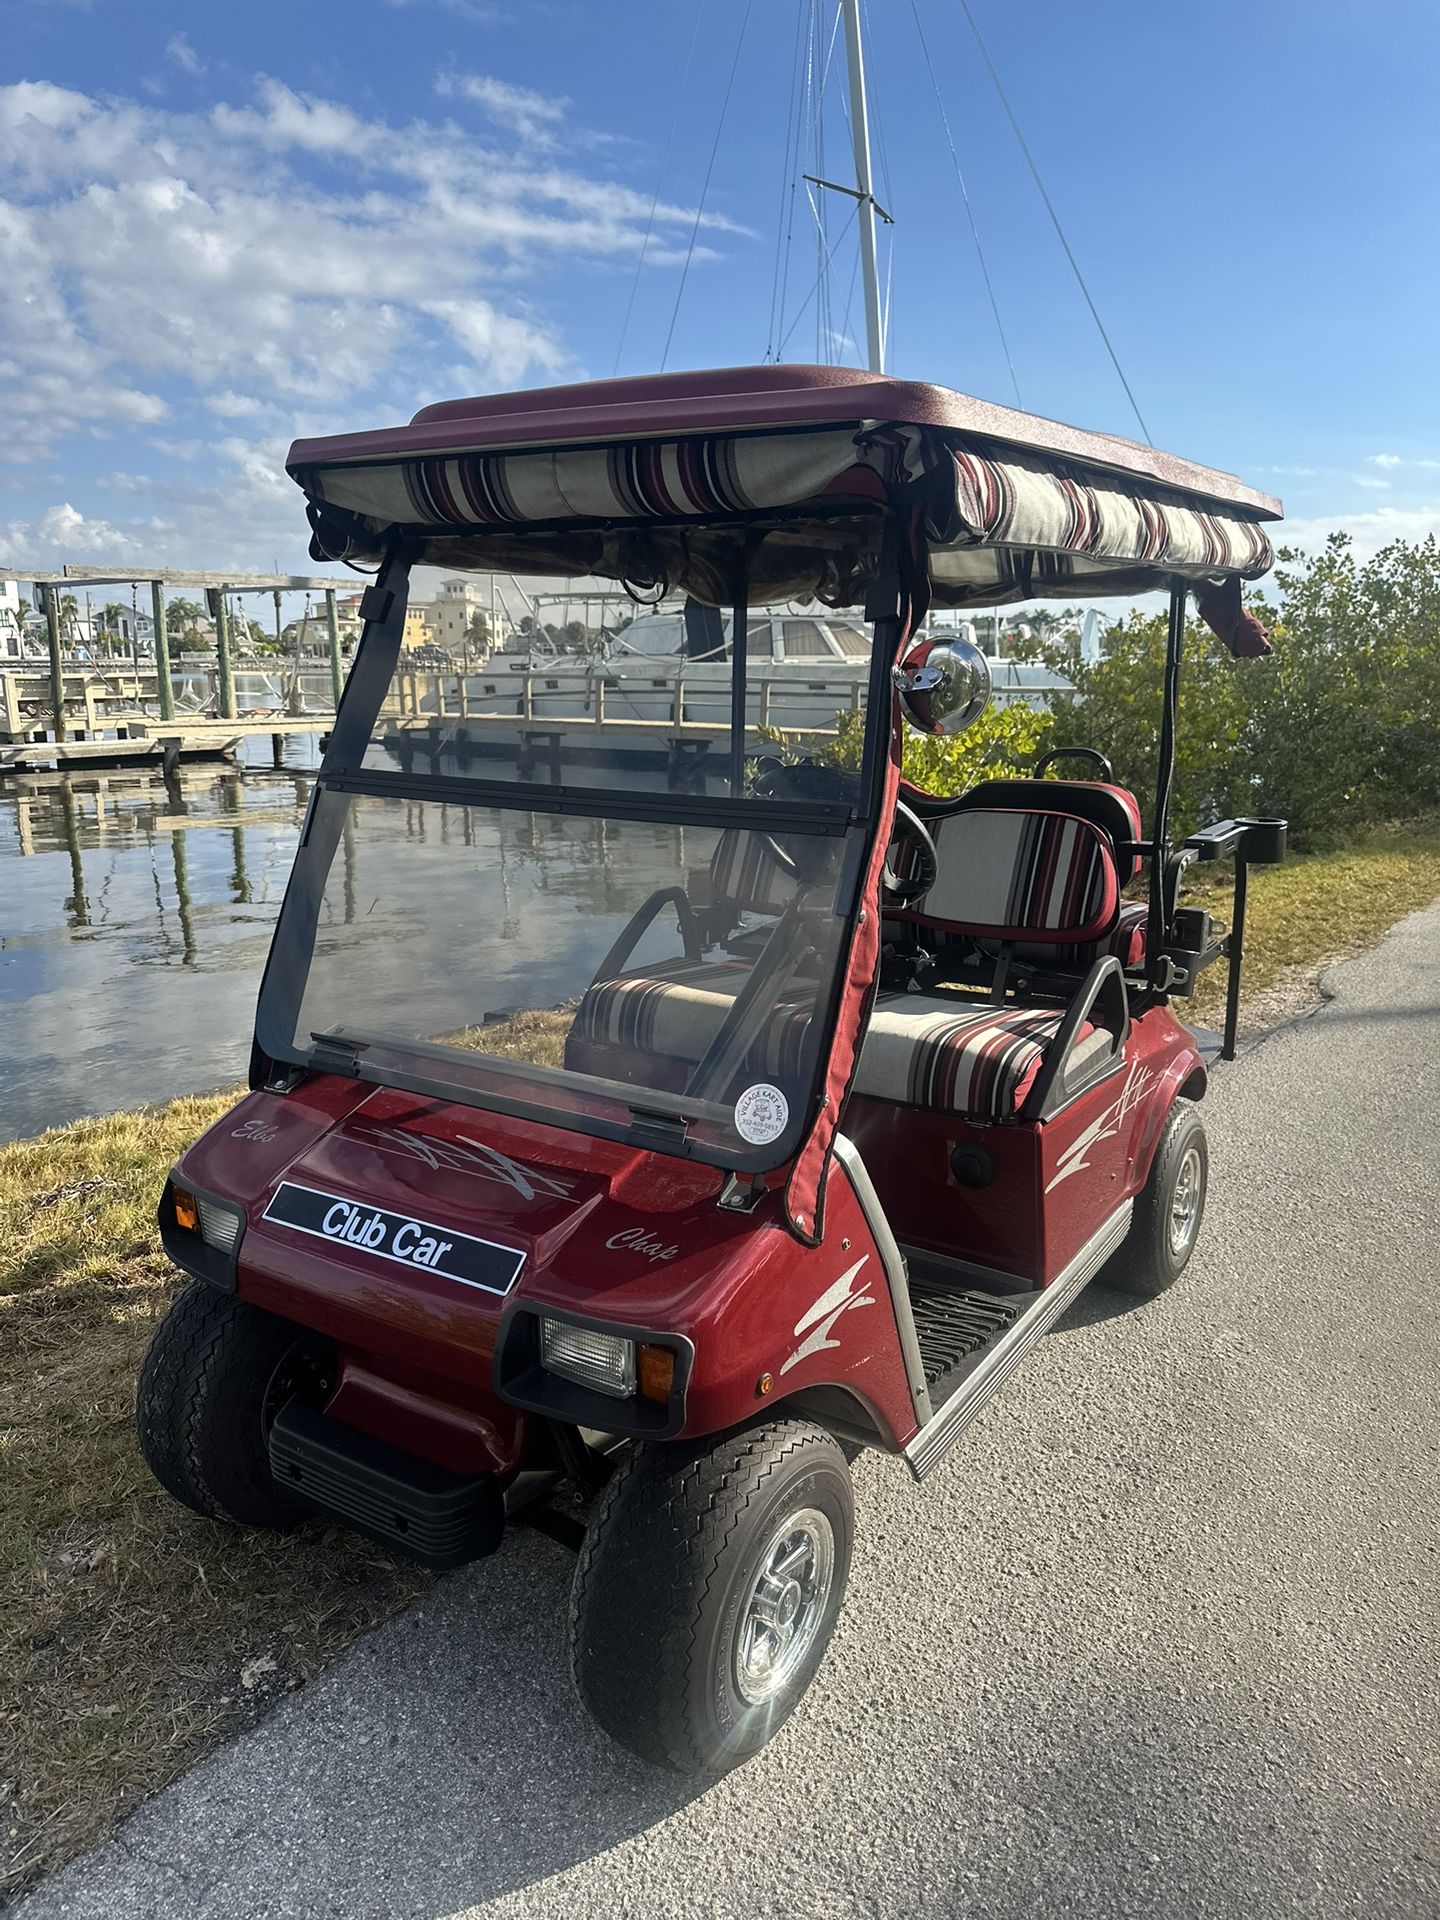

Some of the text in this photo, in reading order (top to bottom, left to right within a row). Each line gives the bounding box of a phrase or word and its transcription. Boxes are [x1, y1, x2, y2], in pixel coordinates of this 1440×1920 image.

[741, 1091, 761, 1116] VILLAGE
[762, 1091, 779, 1103] KART
[322, 1202, 453, 1268] Club Car
[605, 1227, 679, 1263] Chap
